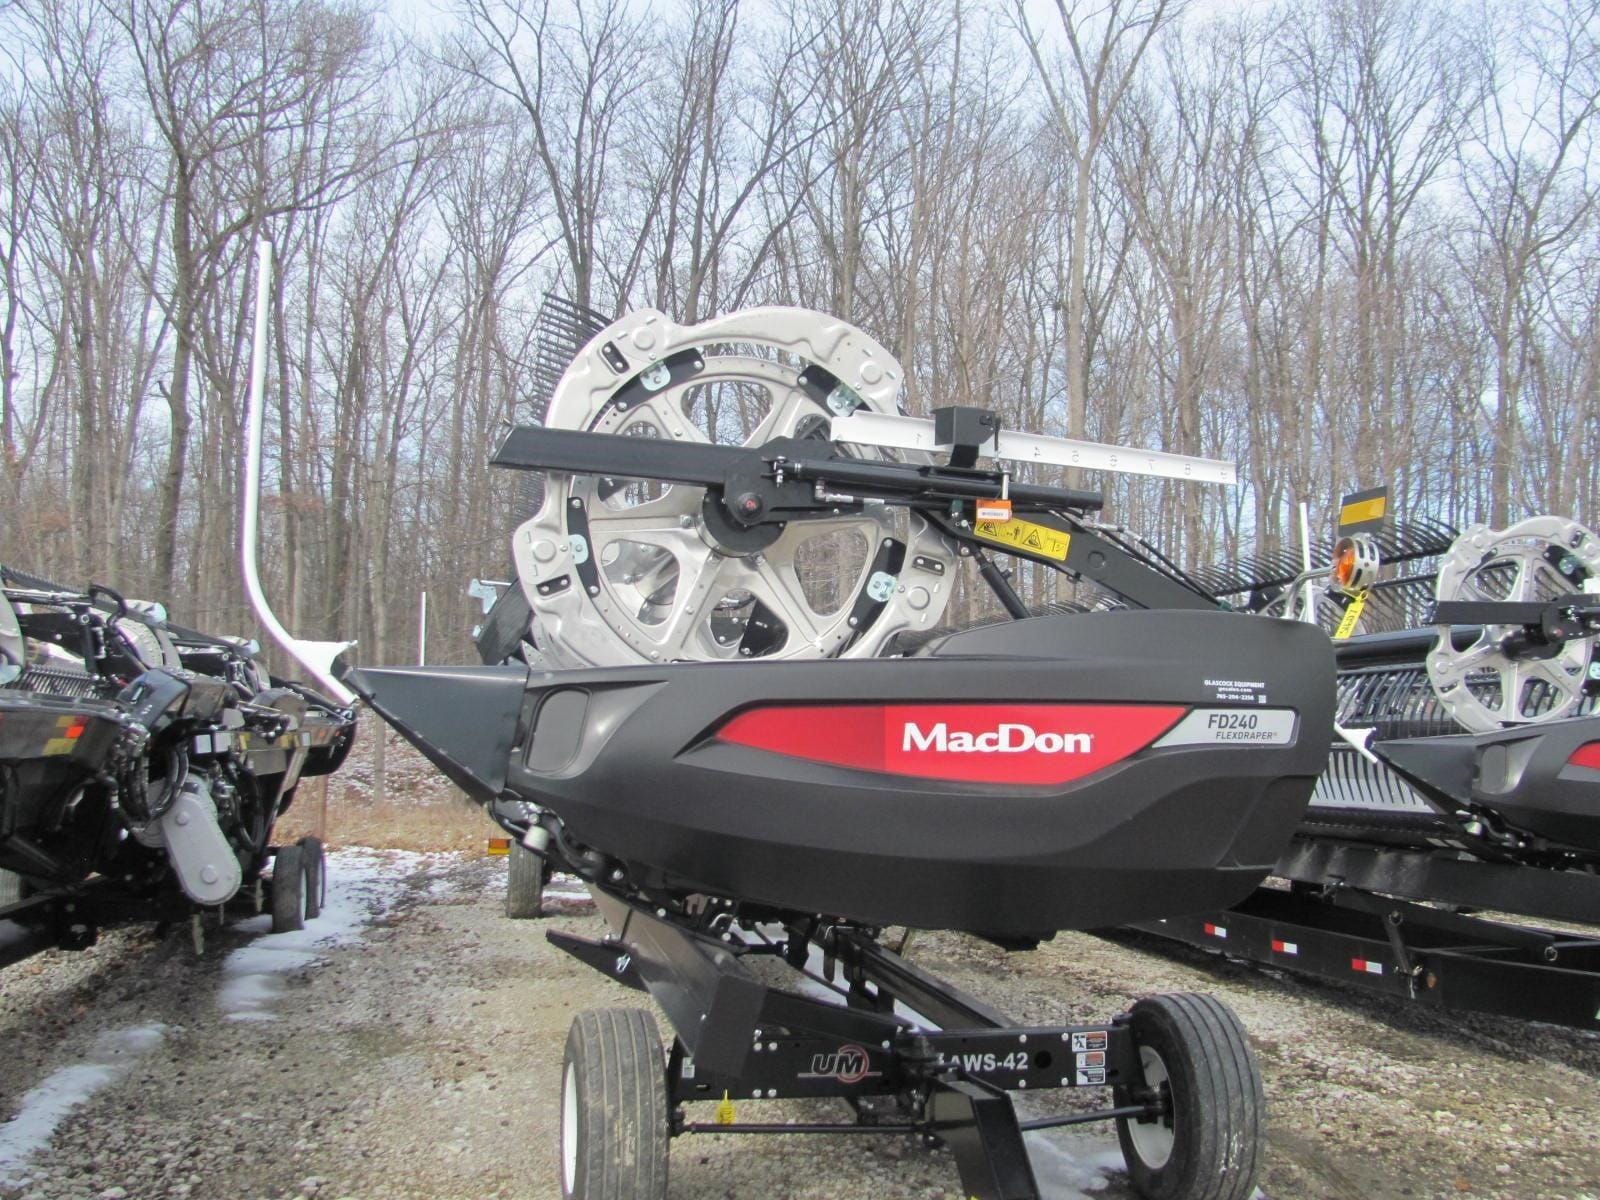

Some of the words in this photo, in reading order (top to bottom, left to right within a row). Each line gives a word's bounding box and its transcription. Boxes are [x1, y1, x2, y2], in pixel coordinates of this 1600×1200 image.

[1208, 713, 1258, 730] FD240
[903, 722, 1091, 753] MacDon
[811, 1051, 867, 1077] UM
